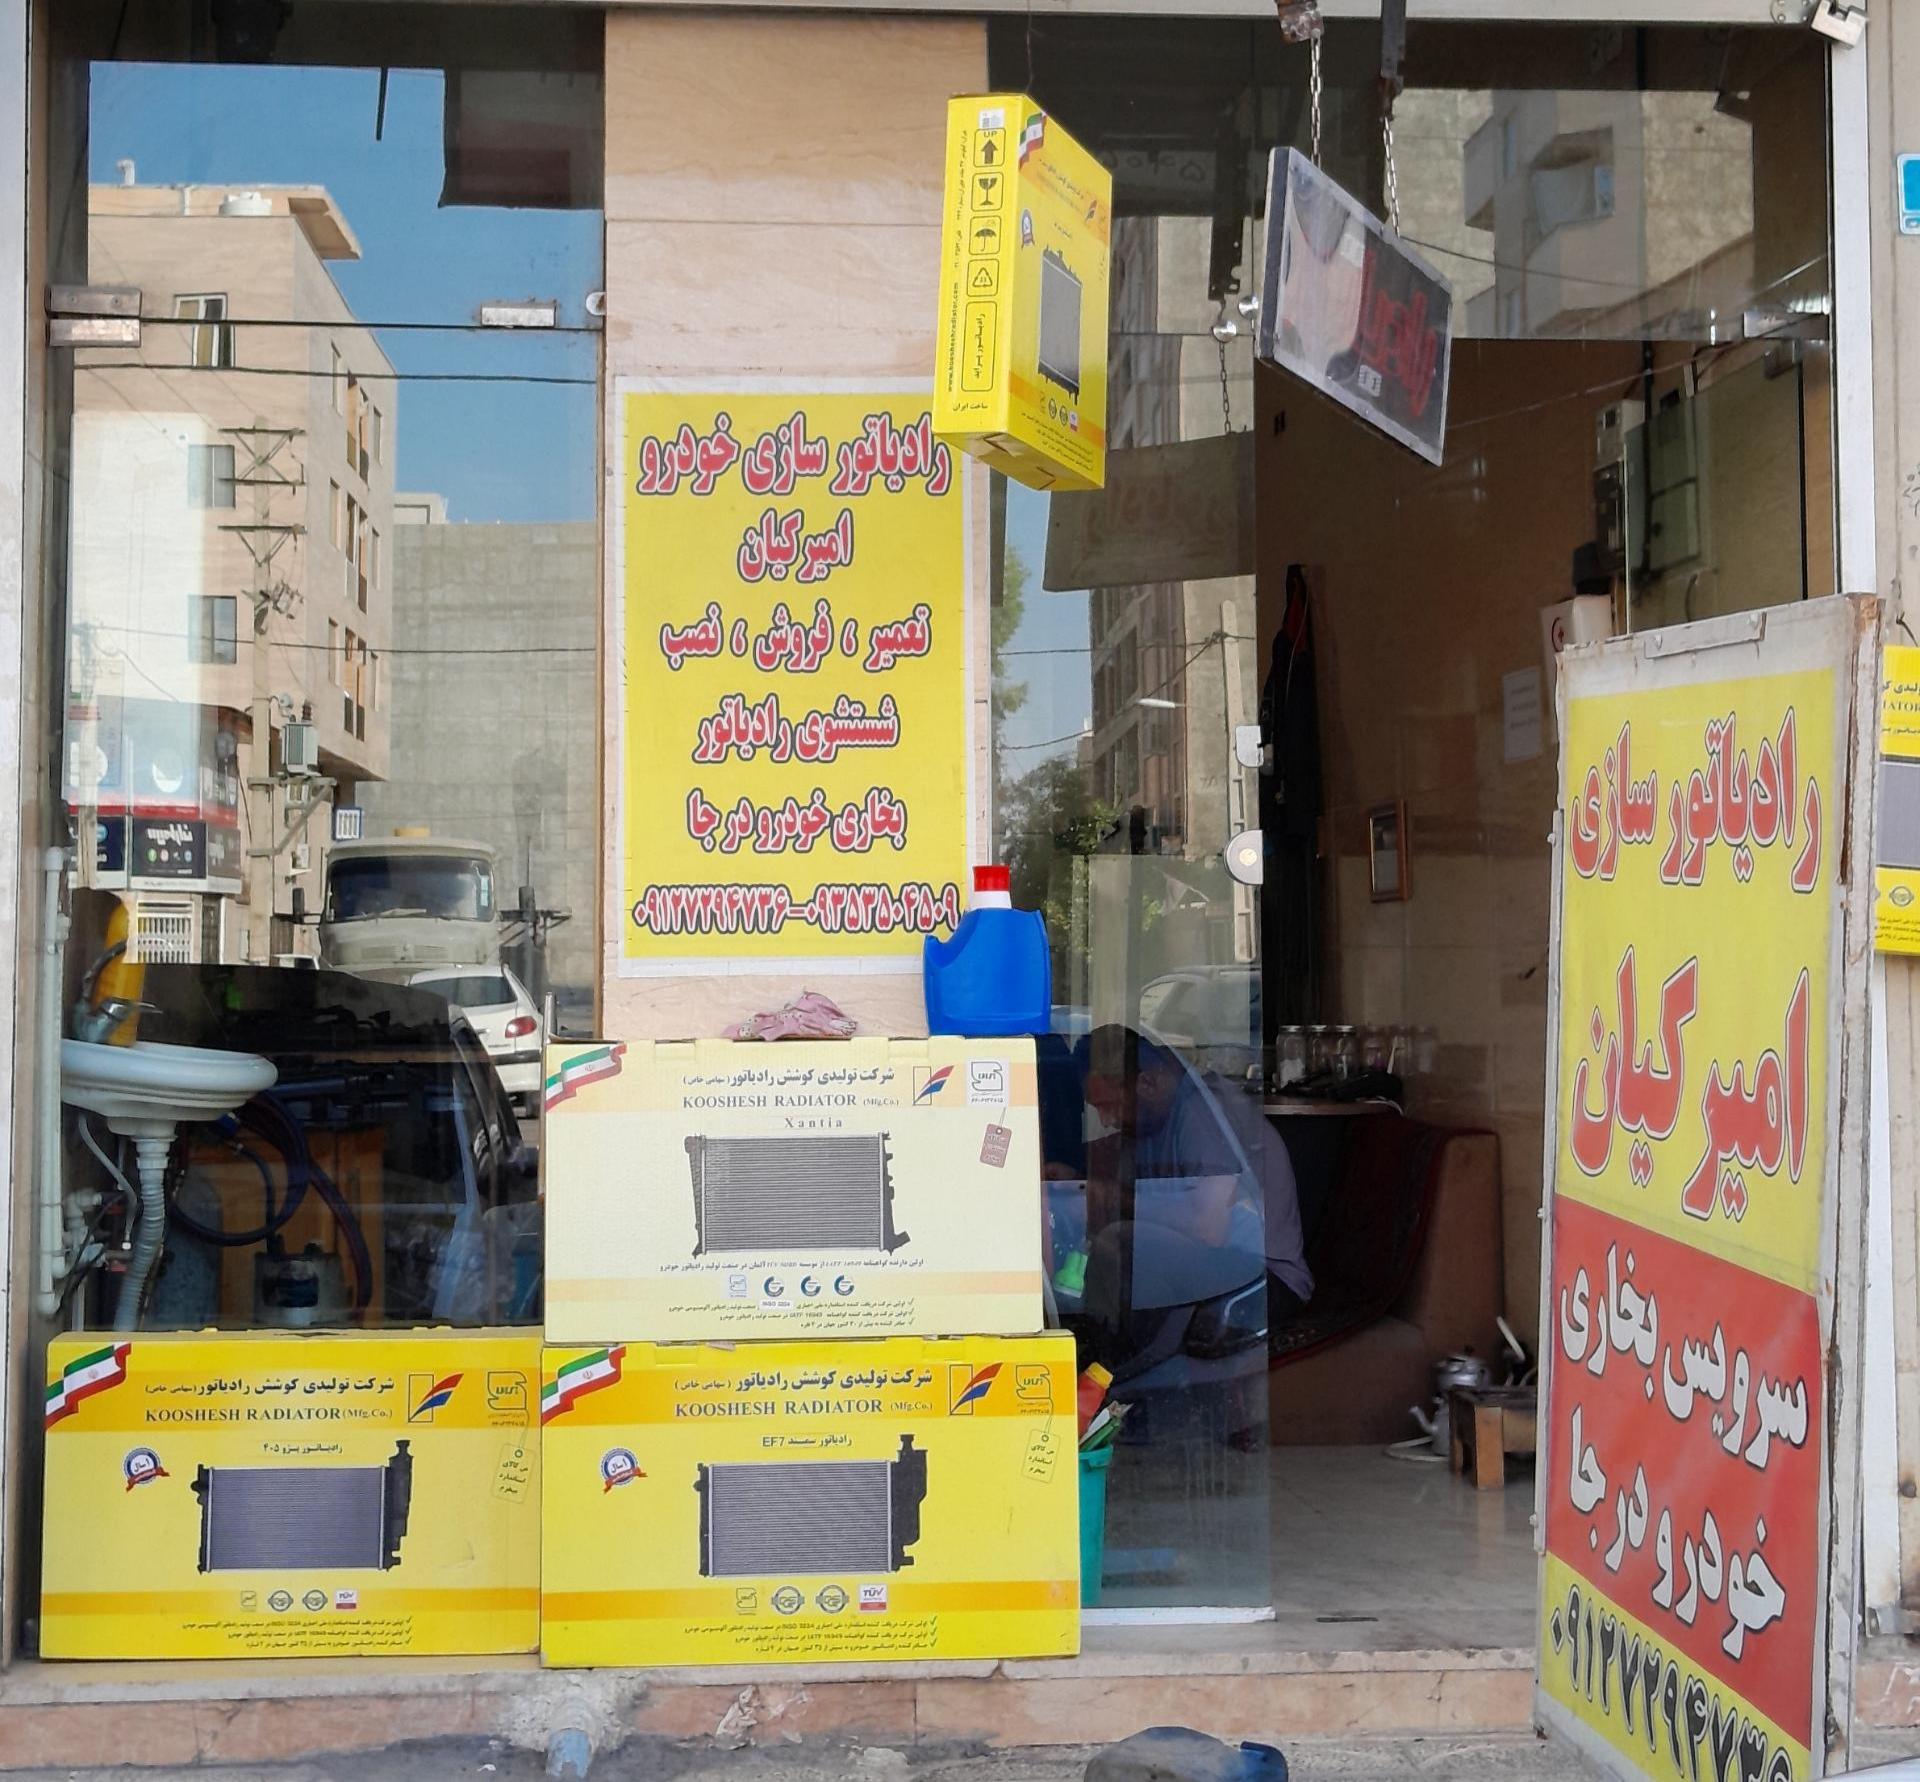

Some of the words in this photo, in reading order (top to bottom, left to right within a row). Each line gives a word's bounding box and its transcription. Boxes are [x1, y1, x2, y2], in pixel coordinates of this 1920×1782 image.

[637, 412, 741, 495] خودرو
[742, 411, 827, 494] سازی
[829, 411, 952, 495] رادیاتور
[737, 507, 804, 581] کیان
[797, 508, 854, 582] امیر
[659, 602, 724, 671] نصب
[752, 599, 833, 672] فروش
[863, 603, 932, 671] تعمیر
[692, 693, 793, 762] رادیاتور
[796, 695, 901, 762] شستشوی
[752, 787, 831, 852] خودرو
[831, 787, 908, 851] بخاری
[1571, 721, 1657, 880] سازی
[1660, 705, 1821, 893] رادیاتور
[730, 1069, 774, 1087] رادیاتور
[777, 1068, 815, 1085] کوشش
[818, 1068, 857, 1086] تولیدی
[860, 1067, 894, 1085] شرکت
[1571, 944, 1697, 1188] کیان
[1681, 967, 1809, 1222] امیر
[683, 1095, 767, 1109] KOOSHESH
[775, 1094, 857, 1107] RADIATOR
[784, 1117, 842, 1128] Xantia
[1561, 1241, 1658, 1402] بخاری
[198, 1378, 250, 1395] رادیاتور
[254, 1378, 299, 1395] کوشش
[303, 1377, 350, 1394] تولیدی
[354, 1377, 394, 1393] شرکت
[675, 1402, 775, 1417] KOOSHESH
[785, 1399, 882, 1414] RADIATOR
[890, 1401, 933, 1411] (Mfg.Co.)
[735, 1372, 787, 1391] رادیاتور
[791, 1371, 836, 1390] کوشش
[840, 1370, 887, 1389] تولیدی
[890, 1369, 932, 1388] شرکت
[1663, 1321, 1808, 1472] سرویس
[146, 1409, 240, 1422] KOOSHESH
[247, 1407, 341, 1421] RADIATOR
[342, 1409, 392, 1419] (Mfg.Co.)
[763, 1436, 785, 1447] EF7
[818, 1435, 852, 1448] رادیاتور
[1652, 1508, 1786, 1661] خودرو
